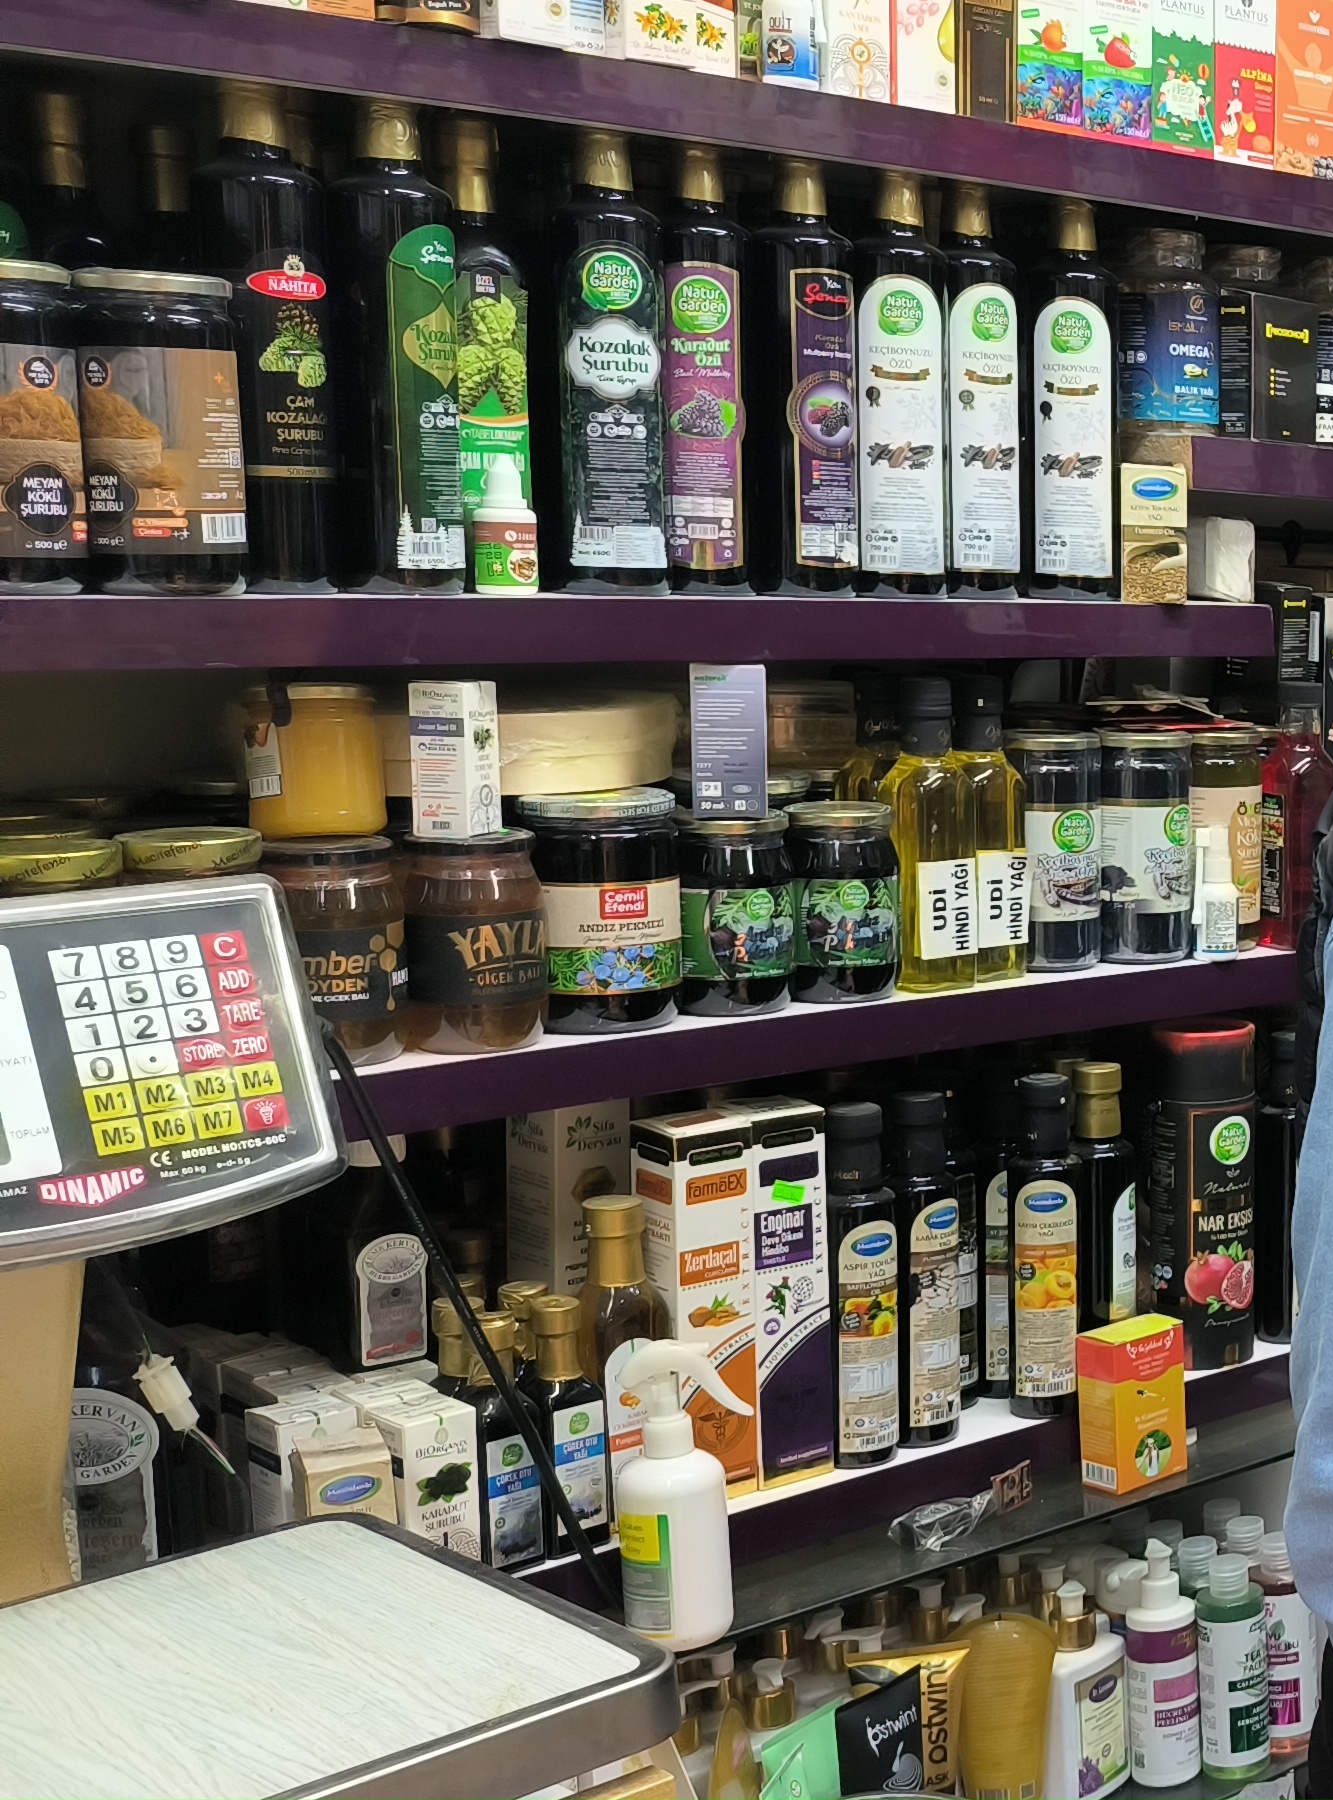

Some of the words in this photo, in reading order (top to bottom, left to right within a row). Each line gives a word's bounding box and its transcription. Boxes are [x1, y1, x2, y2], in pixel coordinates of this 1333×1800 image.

[769, 16, 792, 30] QUIT
[594, 261, 632, 277] Natur
[589, 274, 637, 290] Garden
[682, 285, 720, 300] Natur
[678, 297, 727, 314] Garden
[886, 294, 918, 308] Natur
[980, 303, 1006, 316] Natur
[882, 304, 922, 322] Garden
[976, 312, 1009, 326] Garden
[1058, 315, 1088, 328] Natur
[1054, 325, 1091, 339] Garden
[579, 335, 652, 357] Kozalak
[868, 345, 934, 359] KEÇİBOYNUZU
[1169, 343, 1210, 359] OMEGA
[582, 355, 649, 374] Şurubu
[1042, 362, 1102, 375] KEÇİBOYNUZU
[286, 395, 315, 410] ÇAM
[23, 477, 63, 489] MEYAN
[27, 488, 61, 503] KÖKÜ
[20, 503, 68, 517] ŞURUBU
[950, 863, 969, 898] YAĞI
[604, 890, 645, 903] Cemil
[604, 900, 645, 913] Efendi
[987, 878, 1004, 920] UDİ
[928, 888, 948, 932] UDİ
[578, 921, 616, 933] ANDIZ
[619, 917, 665, 932] PEKMEZİ
[951, 897, 971, 951] HİNDİ
[165, 940, 189, 964] 9
[213, 936, 238, 958] C
[447, 919, 546, 970] YAYLA
[63, 951, 85, 976] 7
[115, 946, 140, 970] 8
[175, 974, 199, 998] 6
[218, 968, 250, 991] ADD
[75, 986, 98, 1011] 4
[124, 980, 149, 1005] 5
[183, 1008, 208, 1032] 3
[222, 1000, 261, 1025] TARE
[133, 1014, 158, 1040] 2
[183, 1042, 223, 1063] STORE
[232, 1035, 268, 1058] ZERO
[90, 1056, 115, 1081] 0
[242, 1068, 274, 1091] M4
[145, 1083, 178, 1106] M2
[194, 1075, 227, 1098] M3
[94, 1091, 128, 1114] M1
[152, 1118, 186, 1140] M6
[202, 1109, 234, 1131] M7
[592, 1118, 616, 1133] Şifa
[9, 1125, 50, 1141] TOPLAM
[102, 1125, 136, 1148] M5
[577, 1132, 622, 1152] Deryası
[181, 1144, 220, 1160] MODEL
[40, 1167, 145, 1206] DINAMIC
[760, 1209, 805, 1234] Enginar
[1197, 1215, 1226, 1233] NAR
[684, 1243, 737, 1274] Zerdaçal
[842, 1261, 865, 1272] ASPİR
[765, 1341, 790, 1370] LIQUID
[789, 1313, 824, 1345] EXTRACT
[79, 1453, 138, 1481] GARDEN
[421, 1501, 470, 1524] KARADUT
[424, 1514, 467, 1535] ŞURUBU
